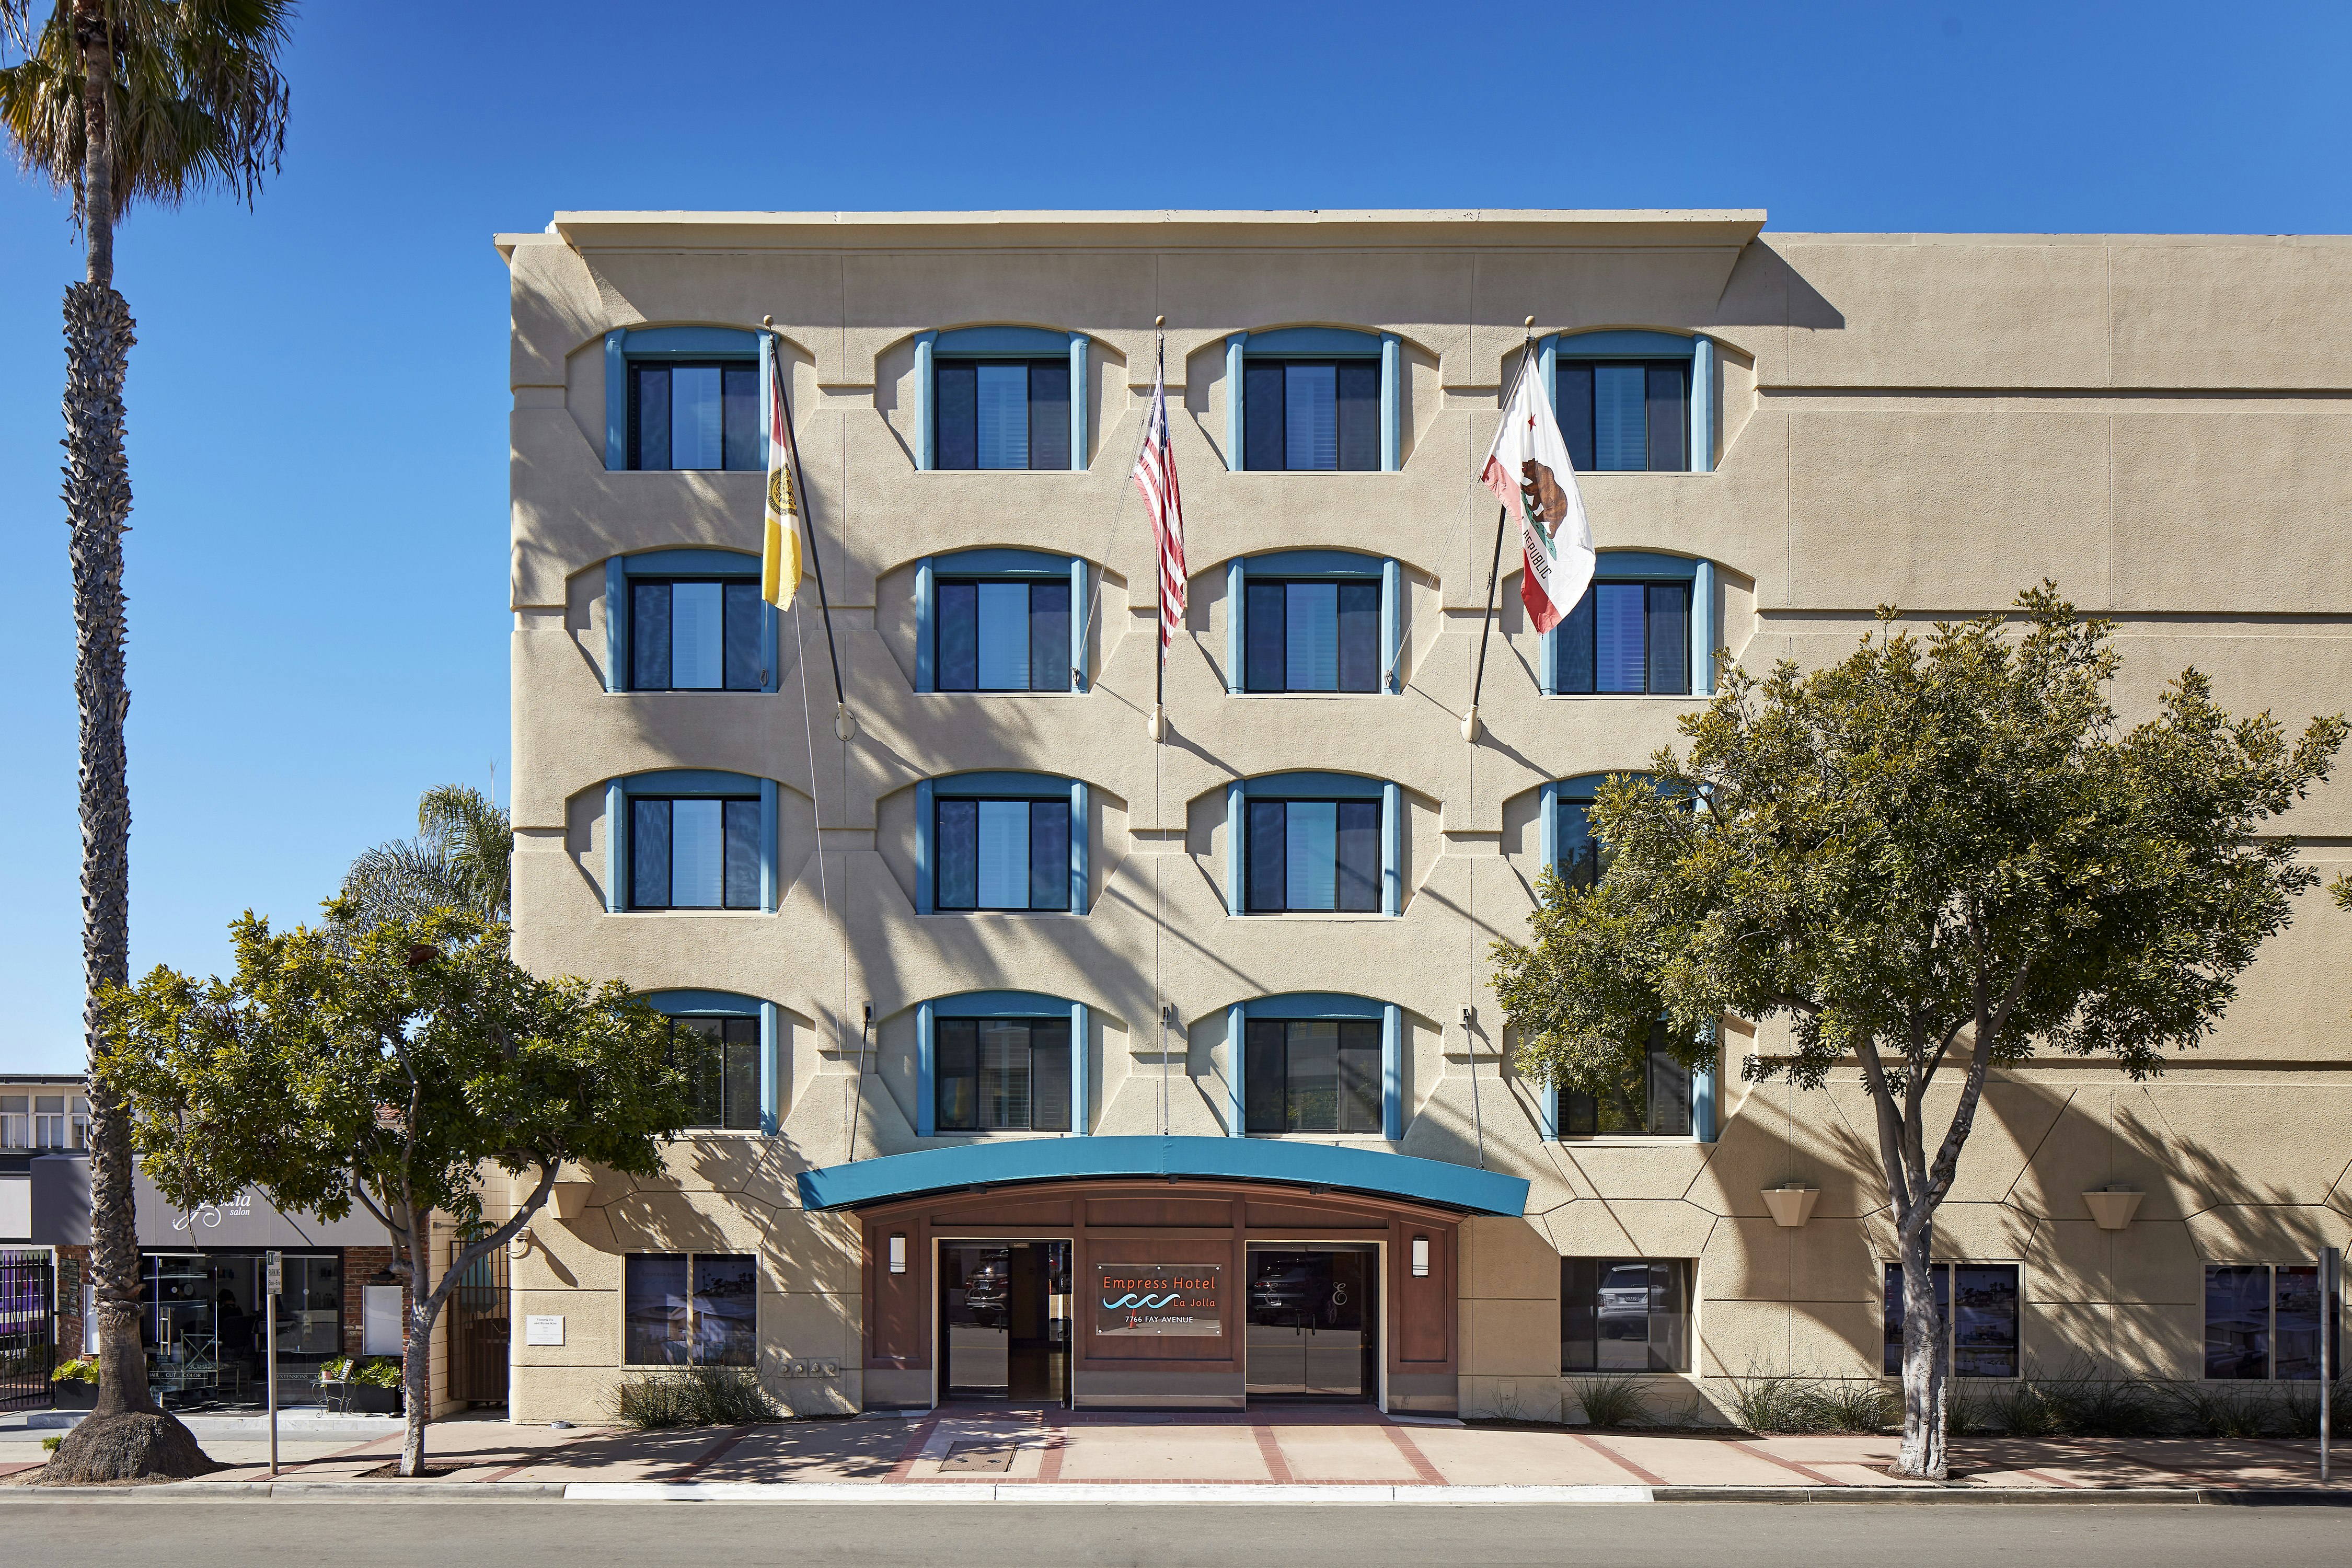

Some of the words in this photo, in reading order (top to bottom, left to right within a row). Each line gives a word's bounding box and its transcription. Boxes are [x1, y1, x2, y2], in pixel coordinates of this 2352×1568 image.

[1523, 529, 1552, 580] REPUBLIC
[229, 1207, 250, 1216] salon
[1103, 1276, 1168, 1292] Empress
[1173, 1276, 1216, 1289] Hotel
[1173, 1298, 1185, 1307] La
[1190, 1298, 1216, 1307] Jolla
